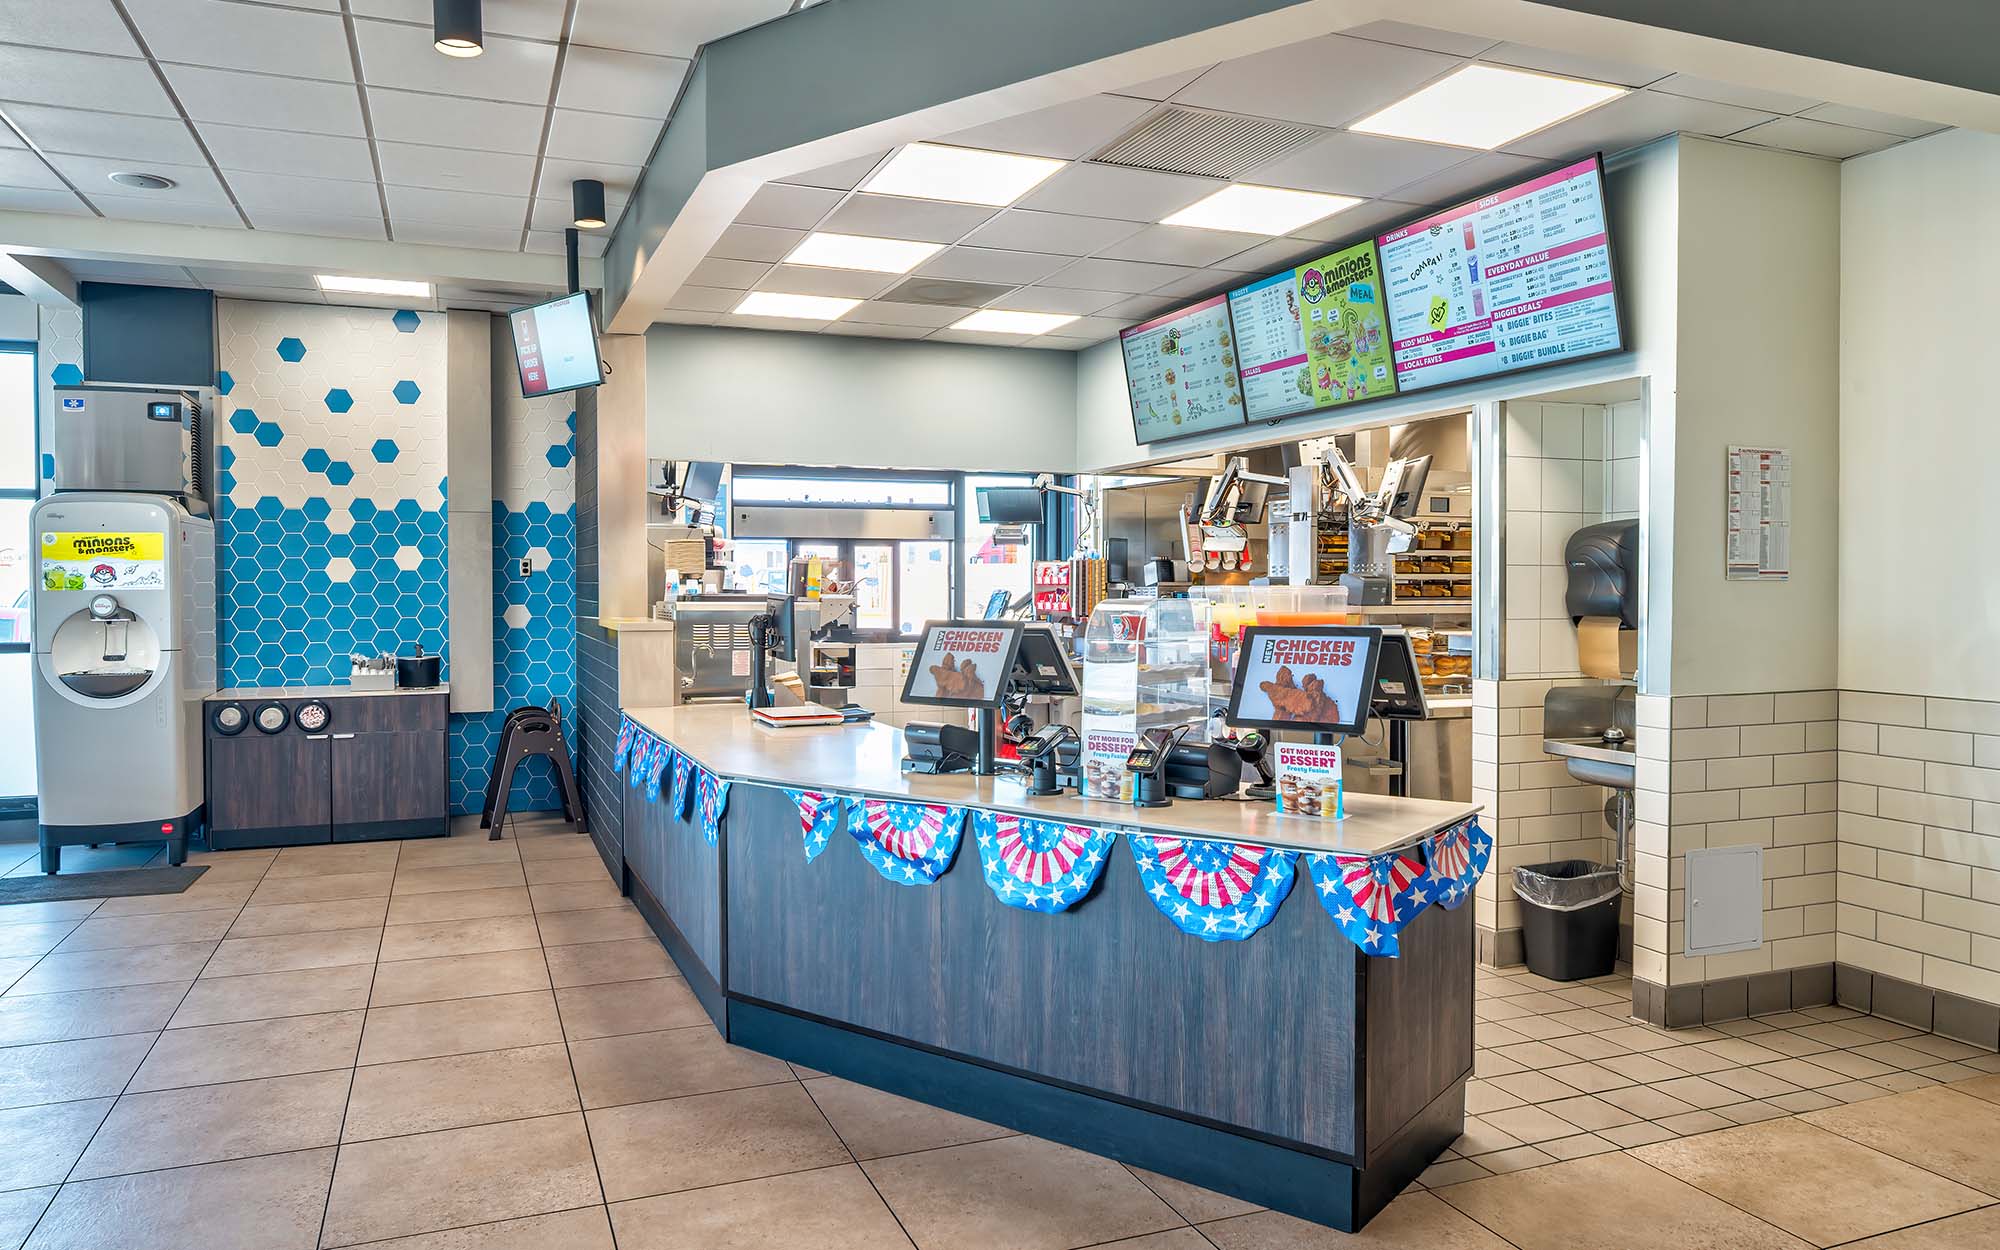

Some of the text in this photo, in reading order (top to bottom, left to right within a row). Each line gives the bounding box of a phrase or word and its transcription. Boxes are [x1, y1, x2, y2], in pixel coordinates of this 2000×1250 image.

[1479, 195, 1499, 209] SIDES
[1385, 230, 1408, 242] DRINKS
[1487, 251, 1550, 276] EVERYDAY VALUE
[1350, 287, 1373, 300] MEAL
[1493, 305, 1517, 319] BIGGIE
[1507, 317, 1530, 331] BIGGIE
[1533, 311, 1553, 324] BITES
[1416, 334, 1434, 344] MEAL
[1509, 334, 1532, 347] BIGGIE
[1532, 330, 1547, 341] BAG
[1511, 350, 1534, 363] BIGGIE
[1537, 343, 1566, 357] BUNDLE
[1404, 355, 1443, 370] LOCAL FAVES
[934, 631, 1004, 651] NEW CHICKEN
[943, 641, 1001, 653] TENDERS
[1263, 639, 1356, 663] NEW CHICKEN
[1274, 652, 1353, 666] TENDERS
[1101, 735, 1120, 743] MORE
[1088, 741, 1135, 754] DESSERT
[1280, 747, 1336, 758] GET MORE FOR
[1280, 755, 1336, 768] DESSERT
[1286, 765, 1308, 773] Frosty
